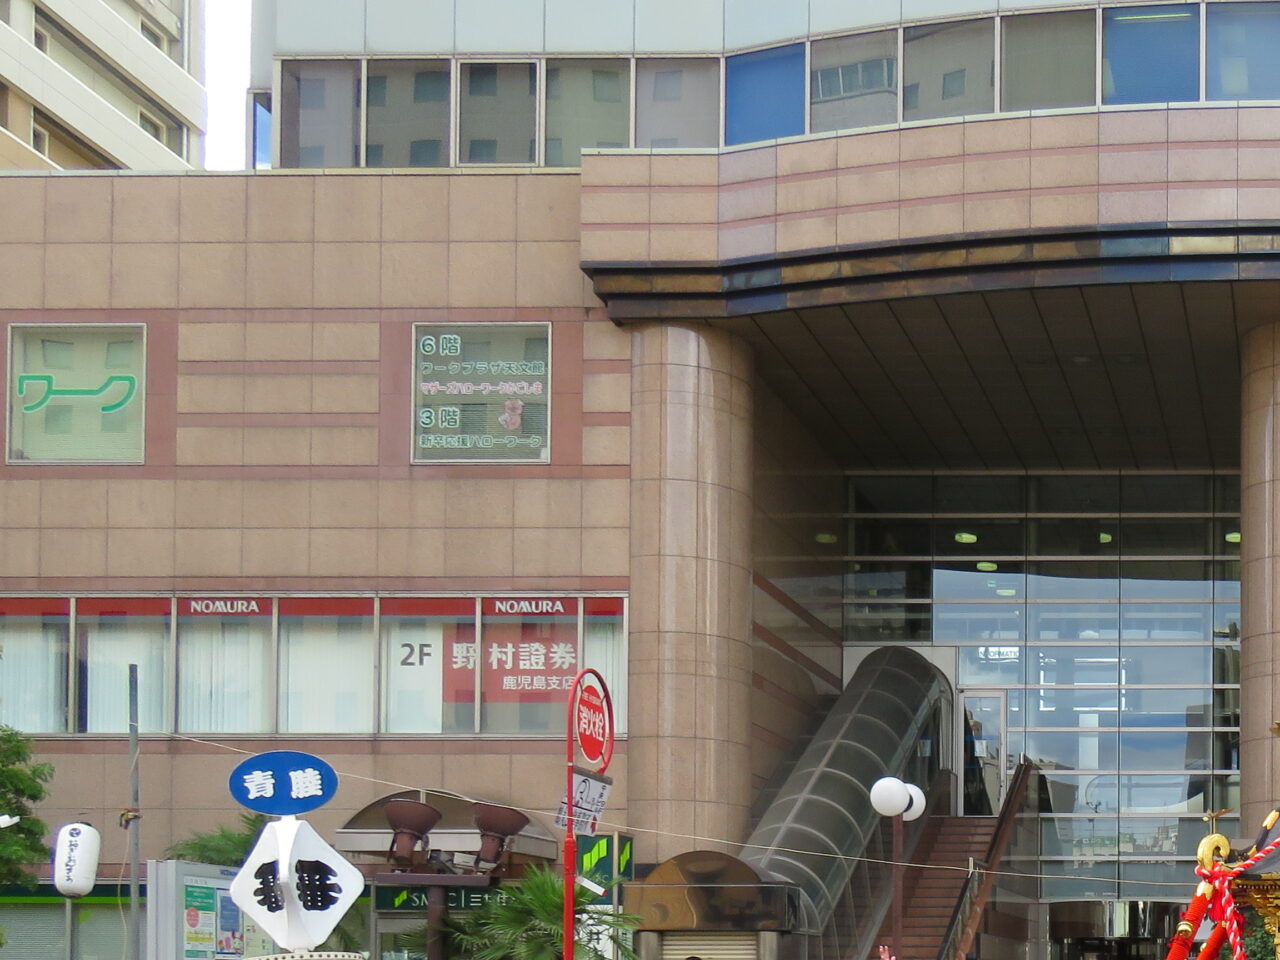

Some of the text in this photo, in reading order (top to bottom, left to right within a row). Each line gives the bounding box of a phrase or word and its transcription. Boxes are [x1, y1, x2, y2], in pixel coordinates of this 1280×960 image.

[420, 334, 461, 356] 6階
[421, 361, 545, 375] ワークプラザ天文館
[17, 375, 137, 413] ワーク
[420, 408, 460, 428] 3階
[419, 435, 542, 448] 新卒応援ハローワーク
[190, 600, 260, 613] NOMURA
[495, 600, 565, 613] NOMURA
[399, 642, 432, 667] 2F
[452, 642, 577, 670] 野村證券
[579, 703, 605, 742] 消火栓
